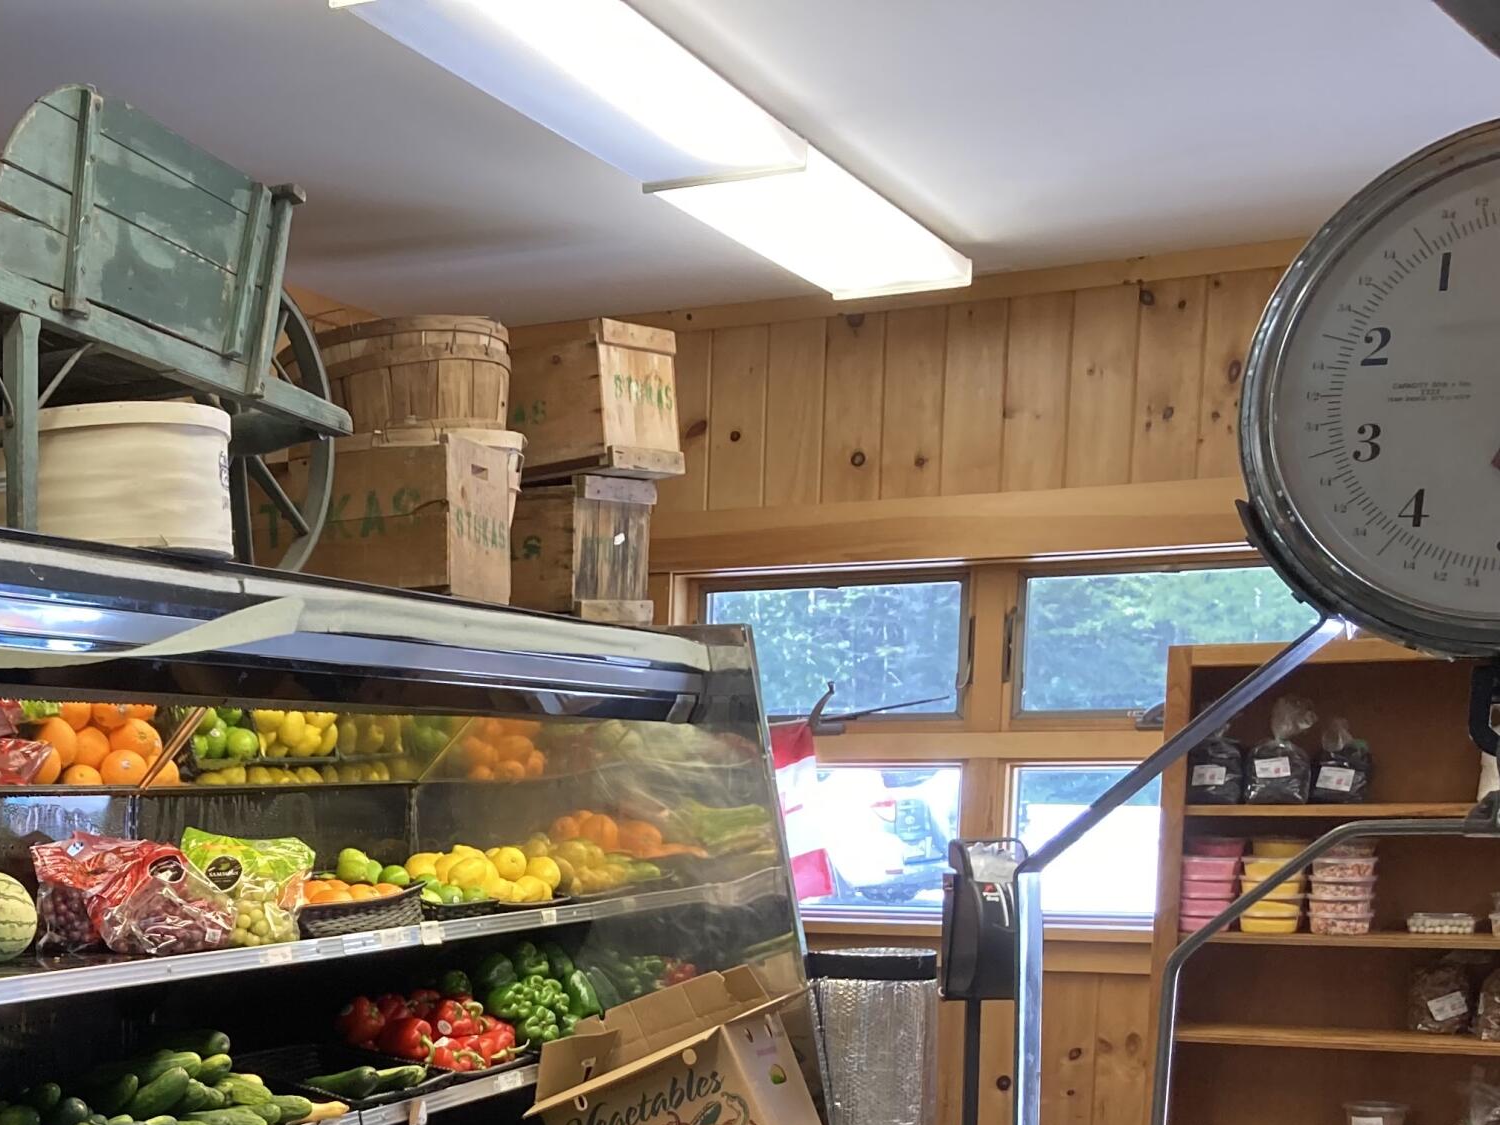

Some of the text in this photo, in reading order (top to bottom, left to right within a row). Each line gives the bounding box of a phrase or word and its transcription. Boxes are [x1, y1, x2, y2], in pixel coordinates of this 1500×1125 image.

[1438, 252, 1452, 292] 1
[1360, 326, 1393, 367] 2
[1352, 423, 1382, 463] 3
[1397, 488, 1430, 528] 4
[455, 507, 507, 550] STUKAS
